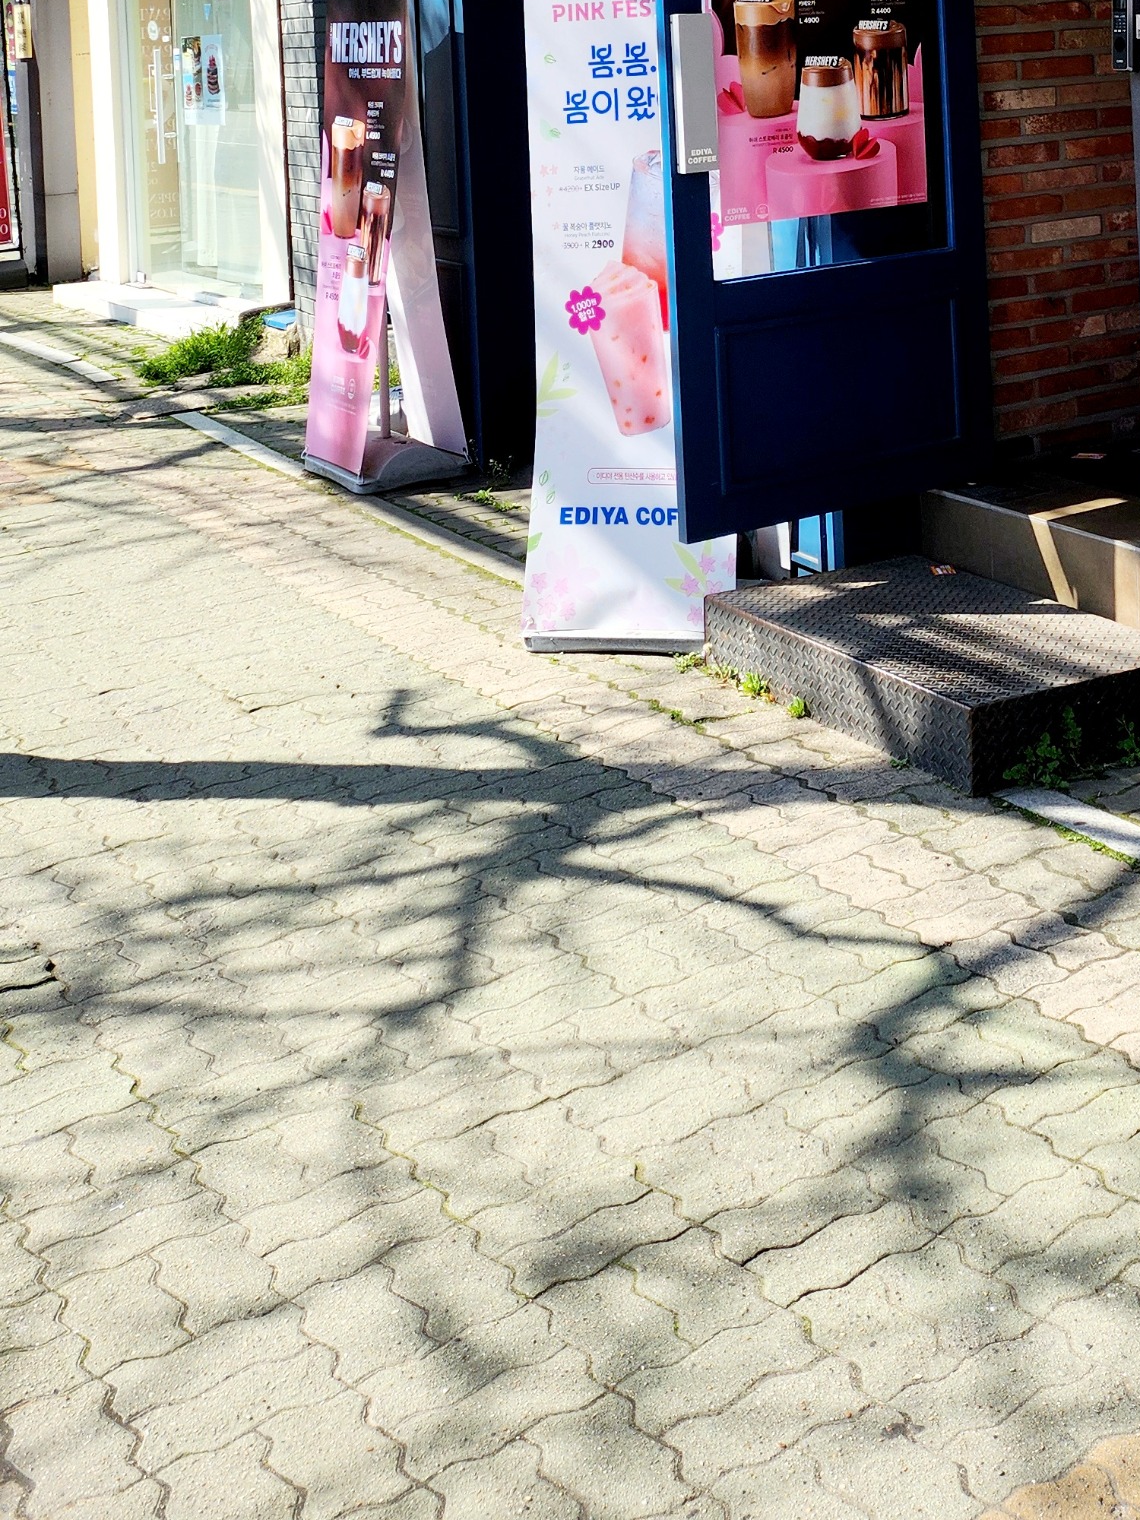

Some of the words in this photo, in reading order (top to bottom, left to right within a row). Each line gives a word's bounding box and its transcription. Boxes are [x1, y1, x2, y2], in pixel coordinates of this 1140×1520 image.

[552, 1, 605, 23] PINK
[804, 16, 819, 24] 4900
[858, 20, 888, 30] HERSHEY'S
[331, 20, 402, 64] HERSHEY'S
[805, 55, 837, 66] HERSHEY'S
[563, 87, 619, 124] 봄이
[691, 148, 713, 156] EDIYA
[688, 156, 717, 165] COFFEE
[585, 183, 593, 192] EX
[595, 182, 610, 192] Size
[610, 182, 621, 191] UP
[727, 207, 748, 215] EDIYA
[724, 213, 750, 221] COFFEE
[592, 240, 614, 249] 2900
[560, 507, 629, 525] EDIYA
[636, 507, 679, 526] COF
